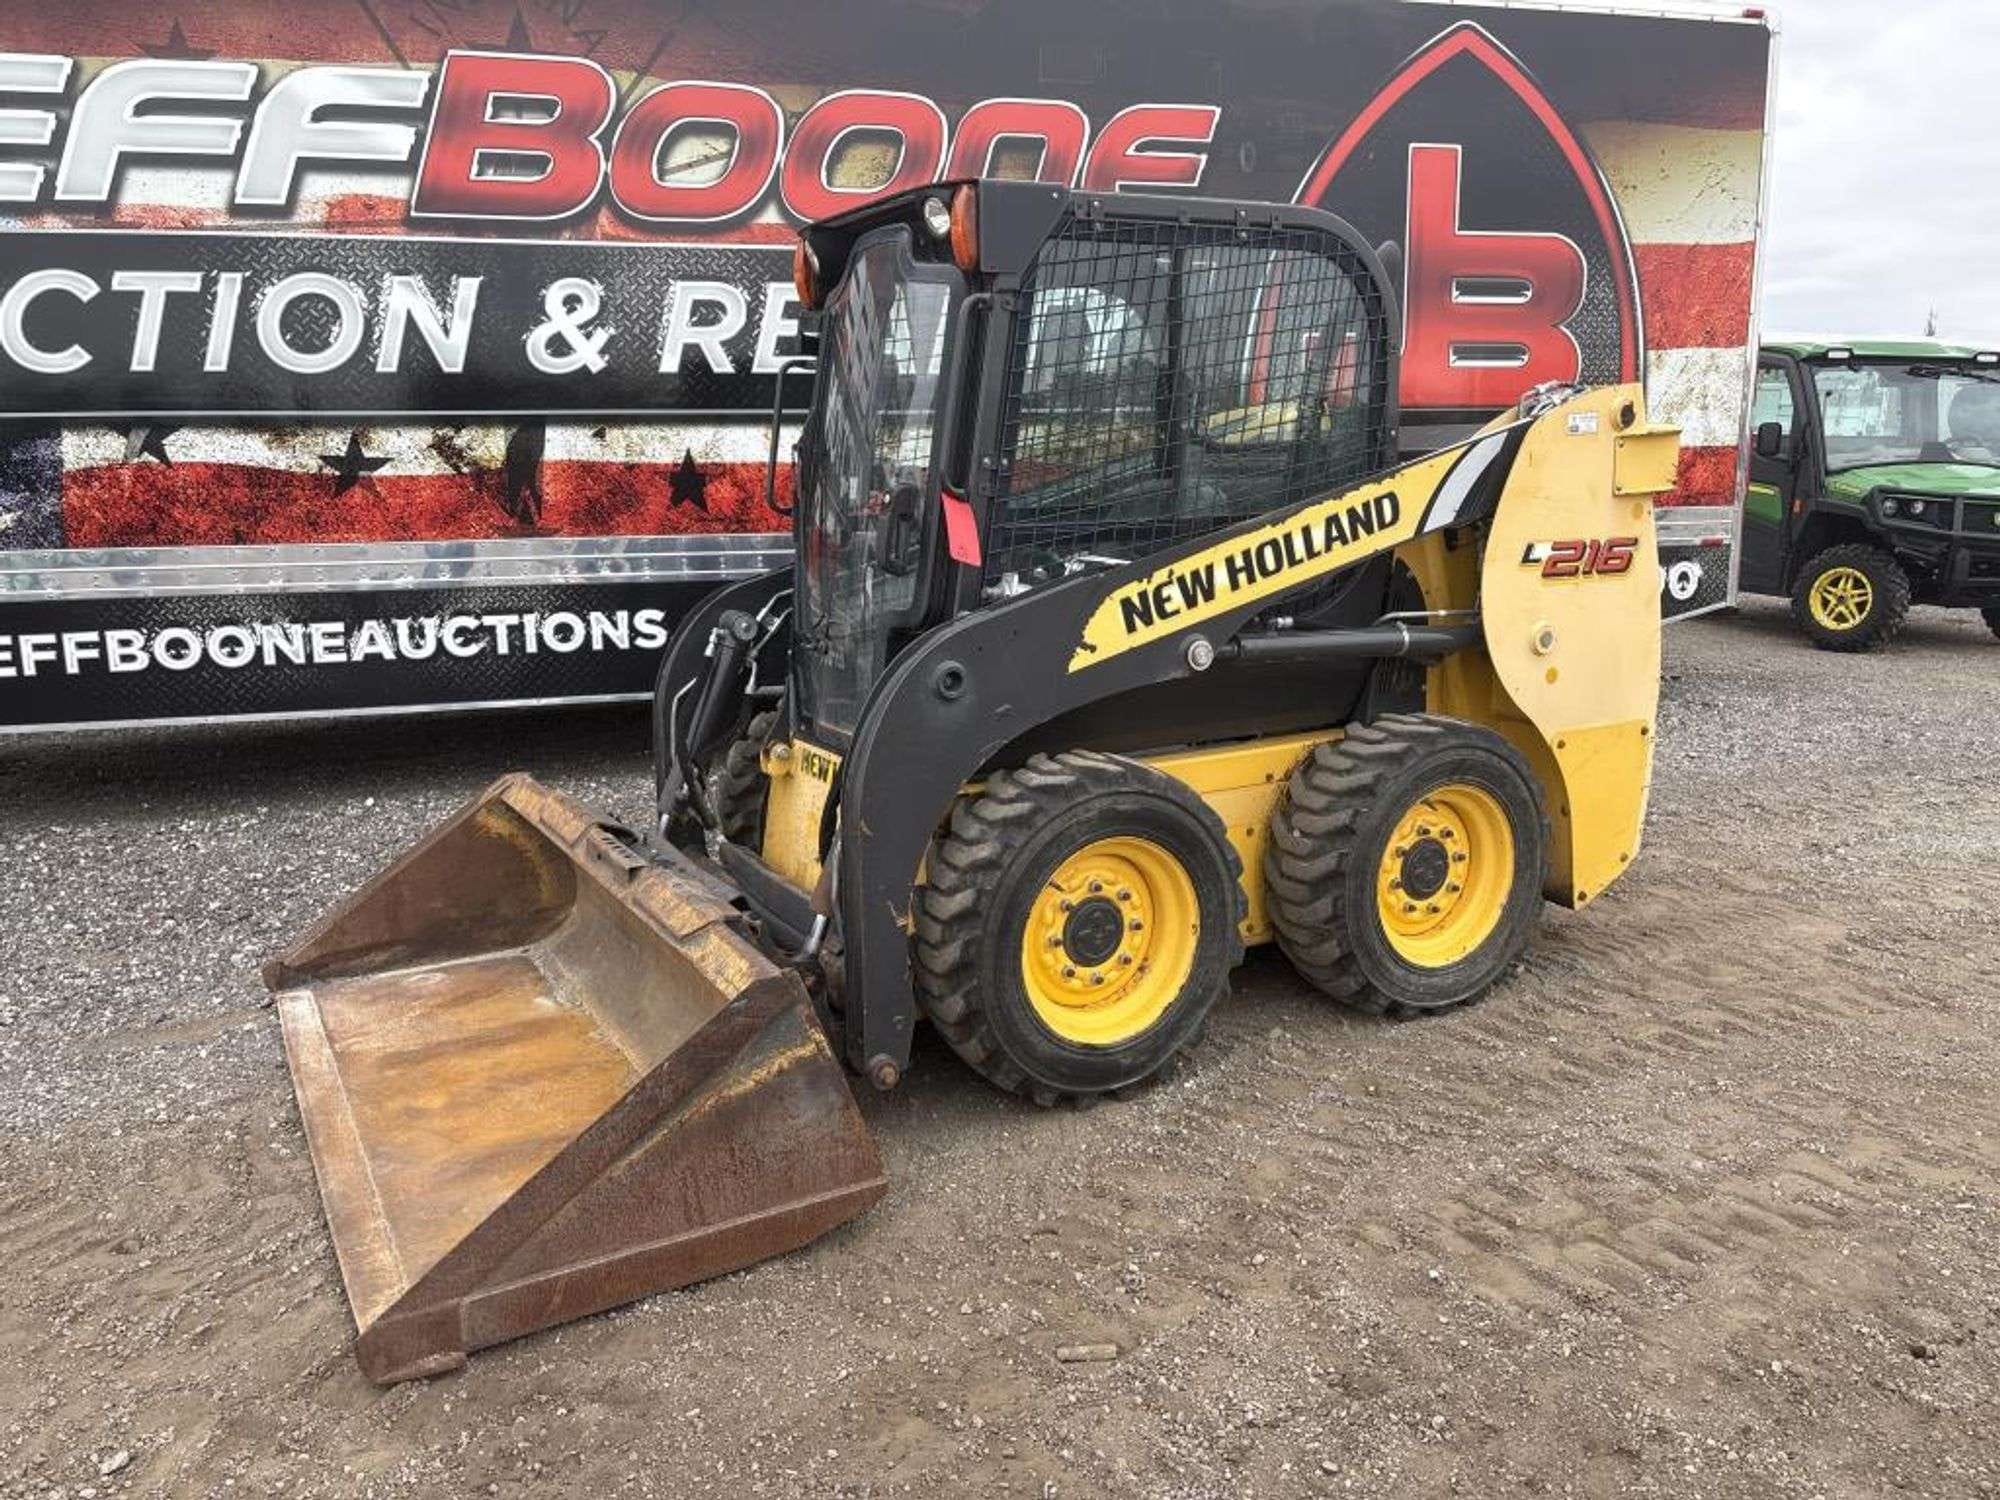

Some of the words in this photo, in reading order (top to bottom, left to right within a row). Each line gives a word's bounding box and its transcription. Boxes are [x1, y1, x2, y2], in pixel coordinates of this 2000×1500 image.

[525, 276, 617, 375] &
[1119, 563, 1215, 635] NEW
[1225, 491, 1400, 592] HOLLAND
